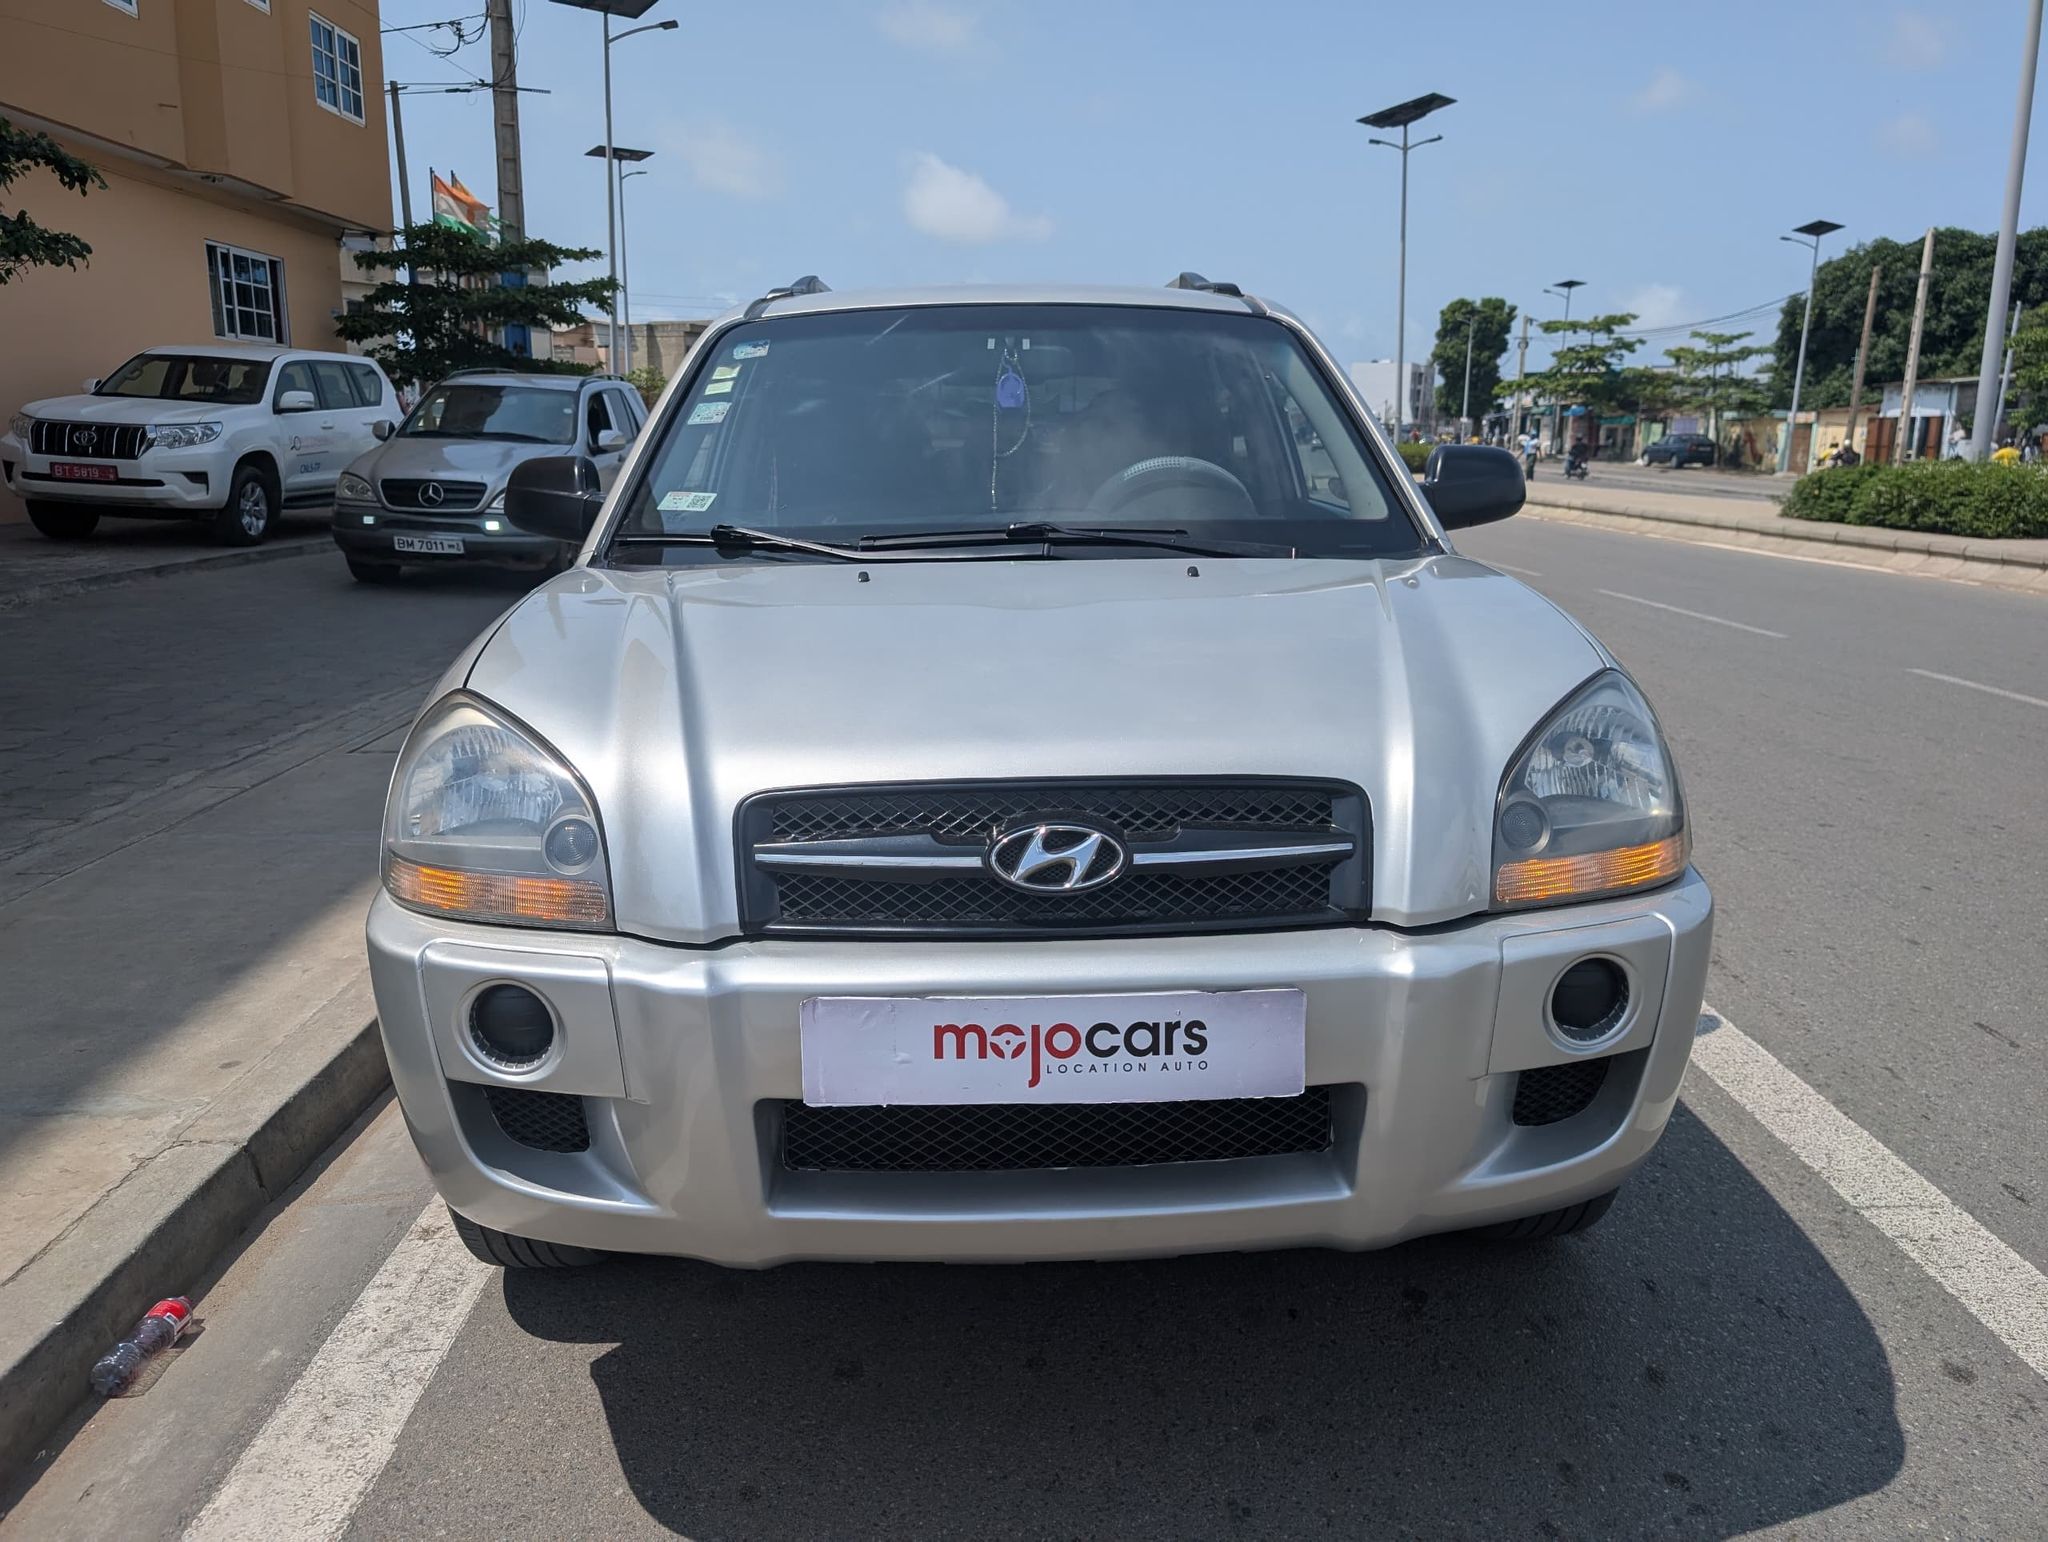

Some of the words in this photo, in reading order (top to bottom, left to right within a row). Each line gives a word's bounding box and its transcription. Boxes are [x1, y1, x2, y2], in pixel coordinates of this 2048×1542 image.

[54, 464, 69, 476] BT
[397, 538, 415, 550] BM
[418, 540, 445, 551] 7011
[933, 1019, 1209, 1088] mojocars
[1046, 1062, 1147, 1074] LOCATION
[1160, 1060, 1209, 1072] AUTO
